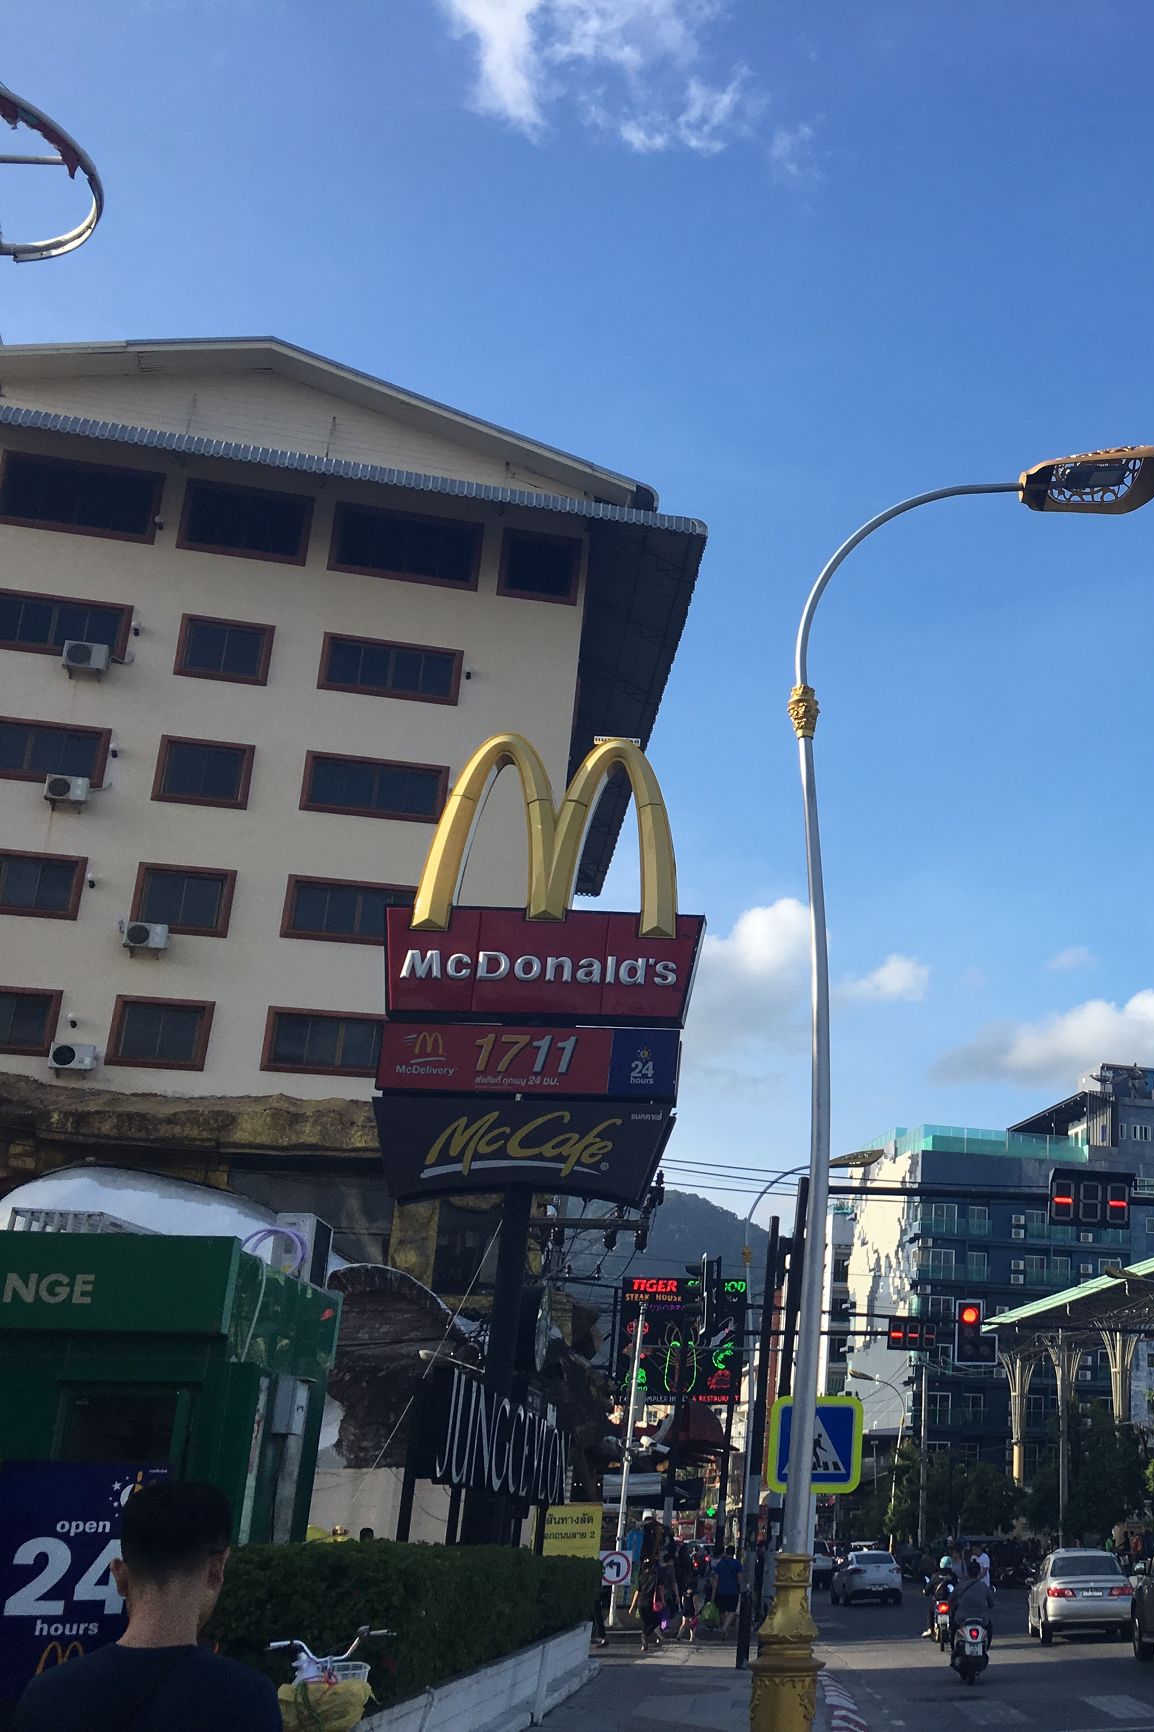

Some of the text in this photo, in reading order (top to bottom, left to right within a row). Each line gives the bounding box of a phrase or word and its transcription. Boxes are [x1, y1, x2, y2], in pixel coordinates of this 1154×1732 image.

[400, 949, 677, 986] McDonald's
[474, 1033, 577, 1074] 1711
[395, 1064, 455, 1077] McDelivery
[631, 1061, 655, 1077] 24
[528, 1076, 541, 1086] 24
[630, 1077, 654, 1085] hours
[2, 1272, 96, 1304] NGE
[632, 1279, 678, 1292] TIGER
[625, 1293, 682, 1302] STEAK HOUSE
[436, 1368, 573, 1504] JUNGCEYLON
[56, 1520, 111, 1536] open
[589, 1530, 596, 1539] 2
[3, 1536, 128, 1616] 24
[34, 1619, 98, 1636] hours
